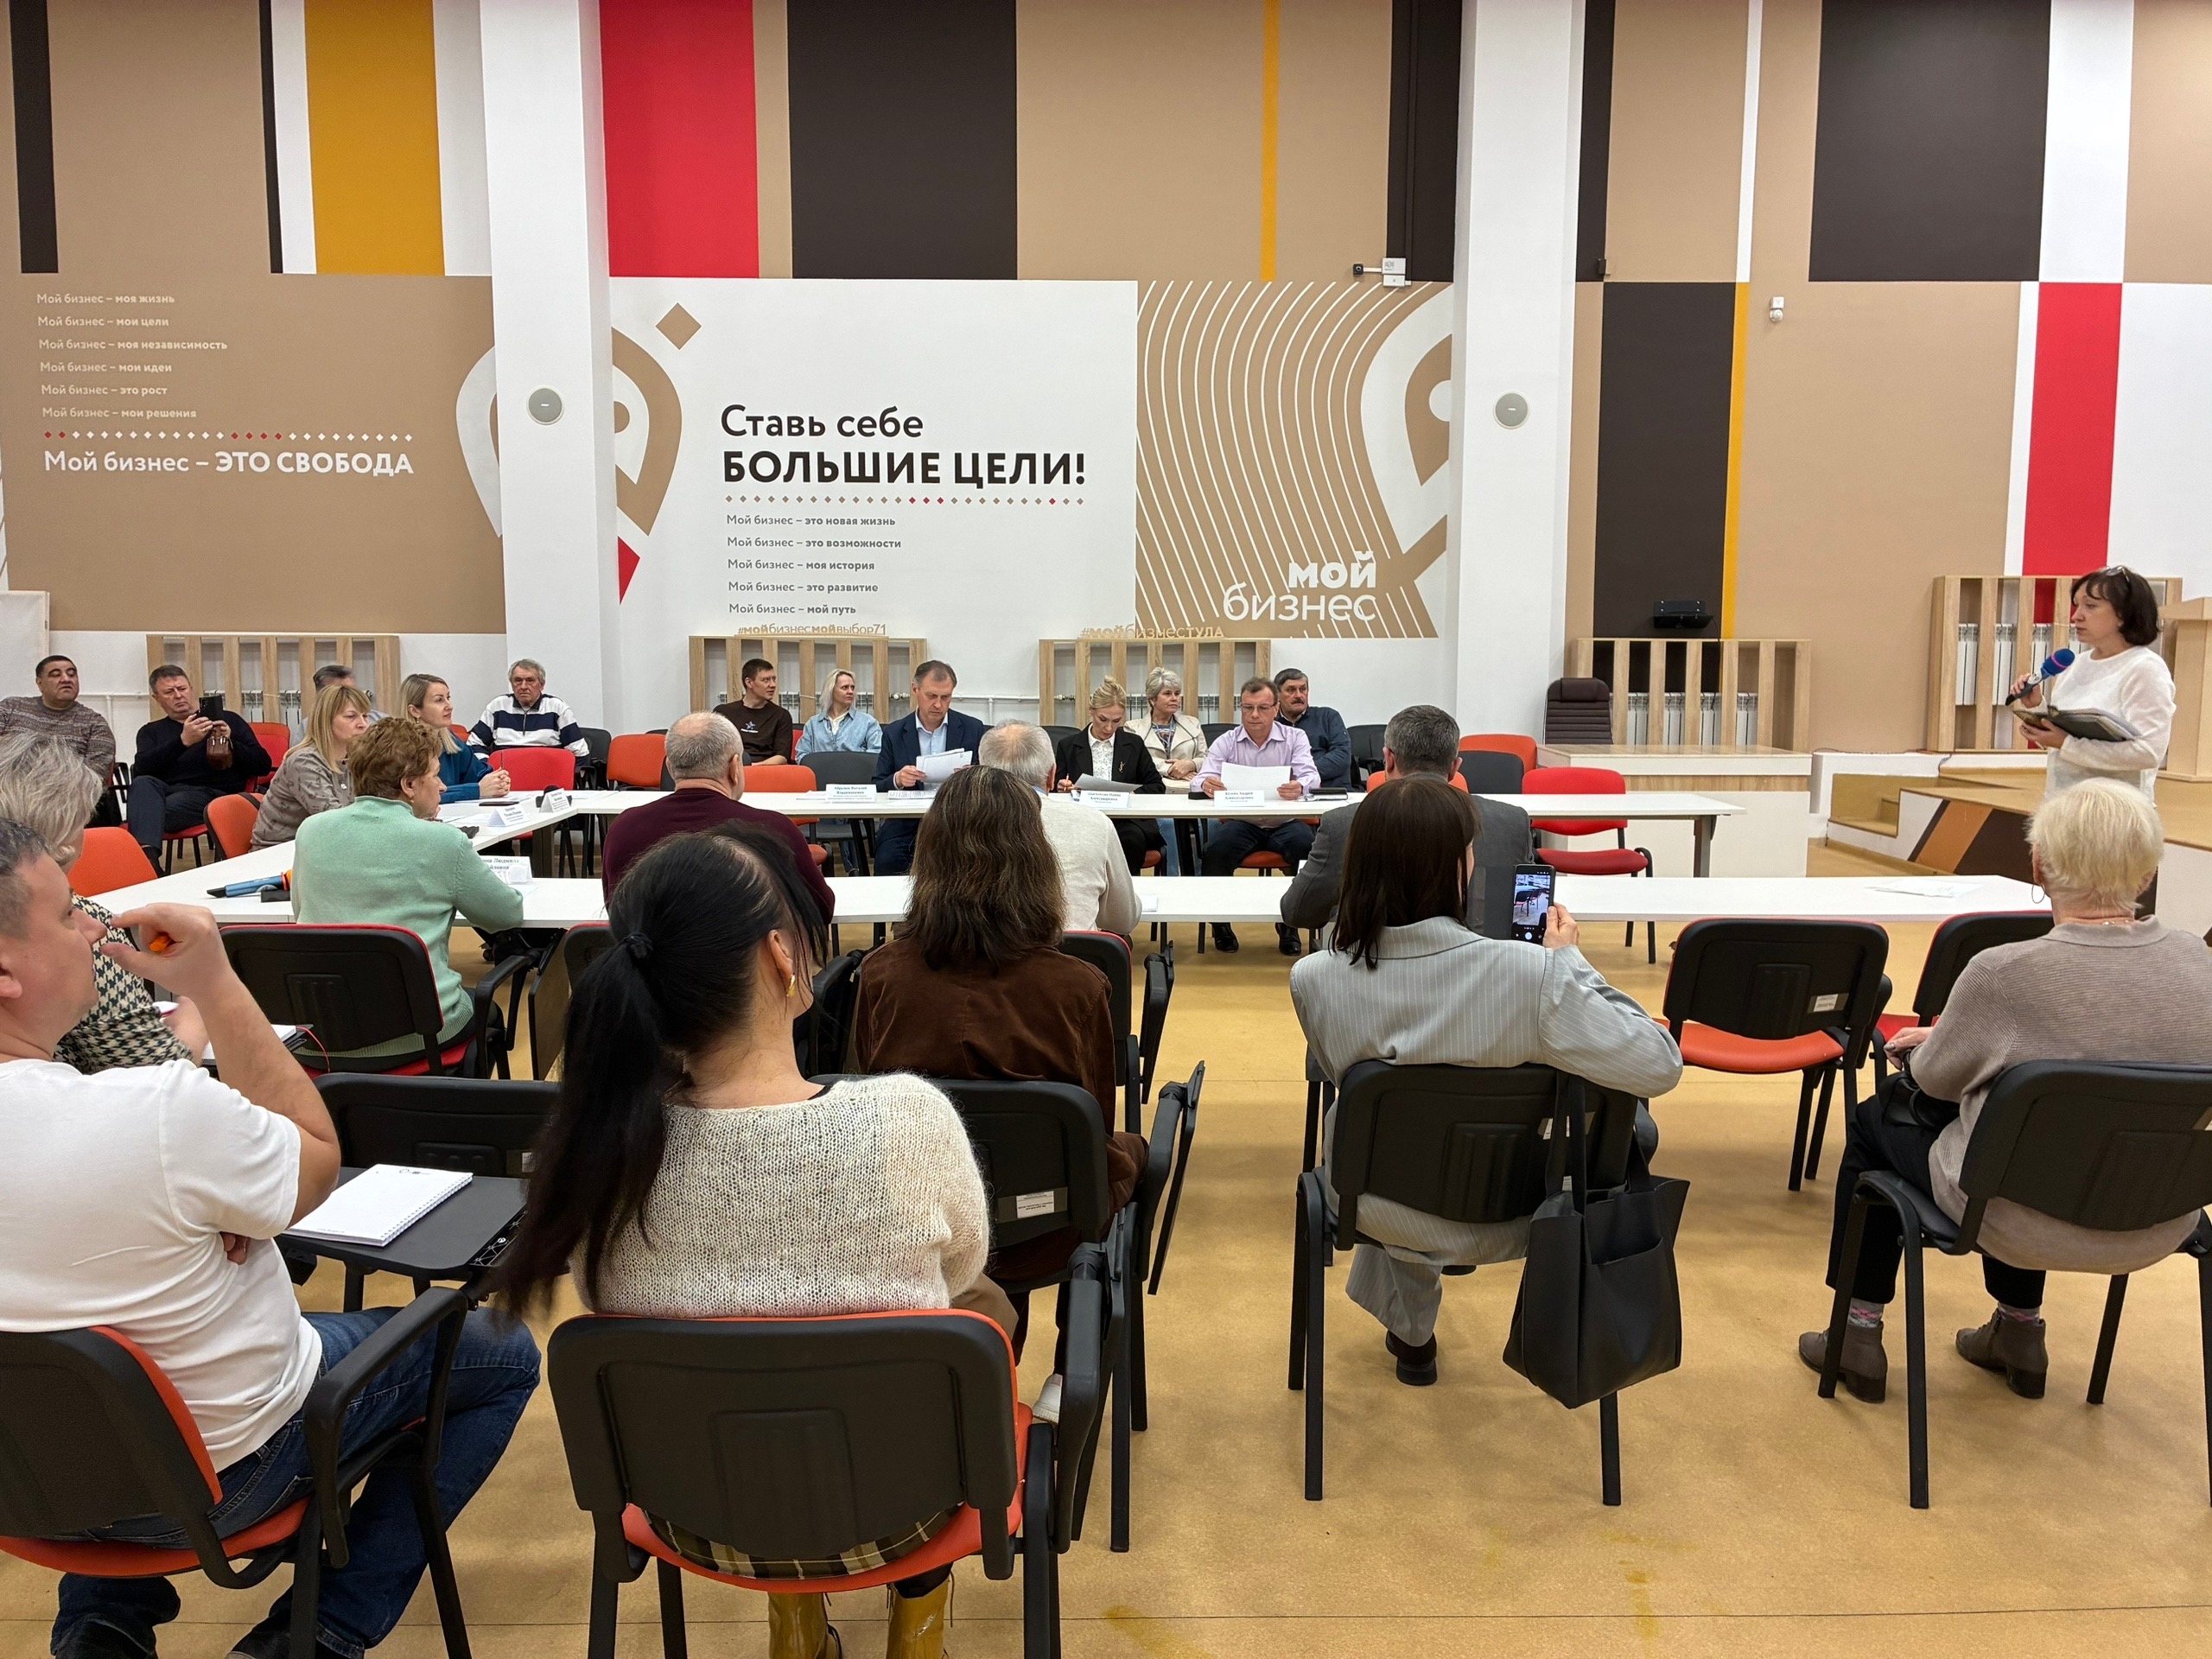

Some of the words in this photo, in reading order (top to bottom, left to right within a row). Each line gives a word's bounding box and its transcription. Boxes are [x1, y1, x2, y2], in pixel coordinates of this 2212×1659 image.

[36, 293, 62, 304] Мой
[64, 293, 104, 304] бизнес
[38, 315, 63, 327] Мой
[64, 315, 105, 327] бизнес
[116, 318, 139, 327] мои
[141, 318, 169, 327] цели
[39, 339, 64, 349] Мой
[66, 339, 106, 350] бизнес
[141, 341, 228, 350] независимость
[40, 361, 65, 372] Мой
[67, 361, 107, 372] бизнес
[118, 364, 142, 372] мои
[143, 364, 172, 373] идеи
[41, 384, 67, 395] Мой
[68, 384, 109, 395] бизнес
[141, 387, 168, 397] рост
[42, 407, 67, 417] Мой
[69, 407, 110, 417] бизнес
[145, 410, 197, 420] решения
[721, 404, 826, 437] Ставь
[836, 405, 924, 438] себе
[44, 450, 98, 472] Мой
[104, 450, 189, 472] бизнес
[215, 451, 270, 473] ЭТО
[276, 451, 414, 477] СВОБОДА
[723, 450, 941, 484] БОЛЬШИЕ
[954, 452, 1085, 490] ЦЕЛИ!
[727, 514, 752, 524] Мой
[753, 514, 793, 525] бизнес
[860, 518, 896, 526] жизнь
[727, 536, 753, 547] Мой
[754, 537, 794, 548] бизнес
[826, 540, 901, 549] возможности
[728, 558, 753, 569] Мой
[754, 559, 795, 569] бизнес
[829, 562, 875, 573] история
[1287, 550, 1376, 589] мой
[728, 581, 753, 592] Мой
[755, 582, 795, 592] бизнес
[827, 584, 879, 594] развитие
[1223, 581, 1376, 621] бизнес
[728, 603, 754, 613] Мой
[756, 603, 796, 613] бизнес
[806, 603, 830, 614] мой
[831, 607, 856, 616] путь
